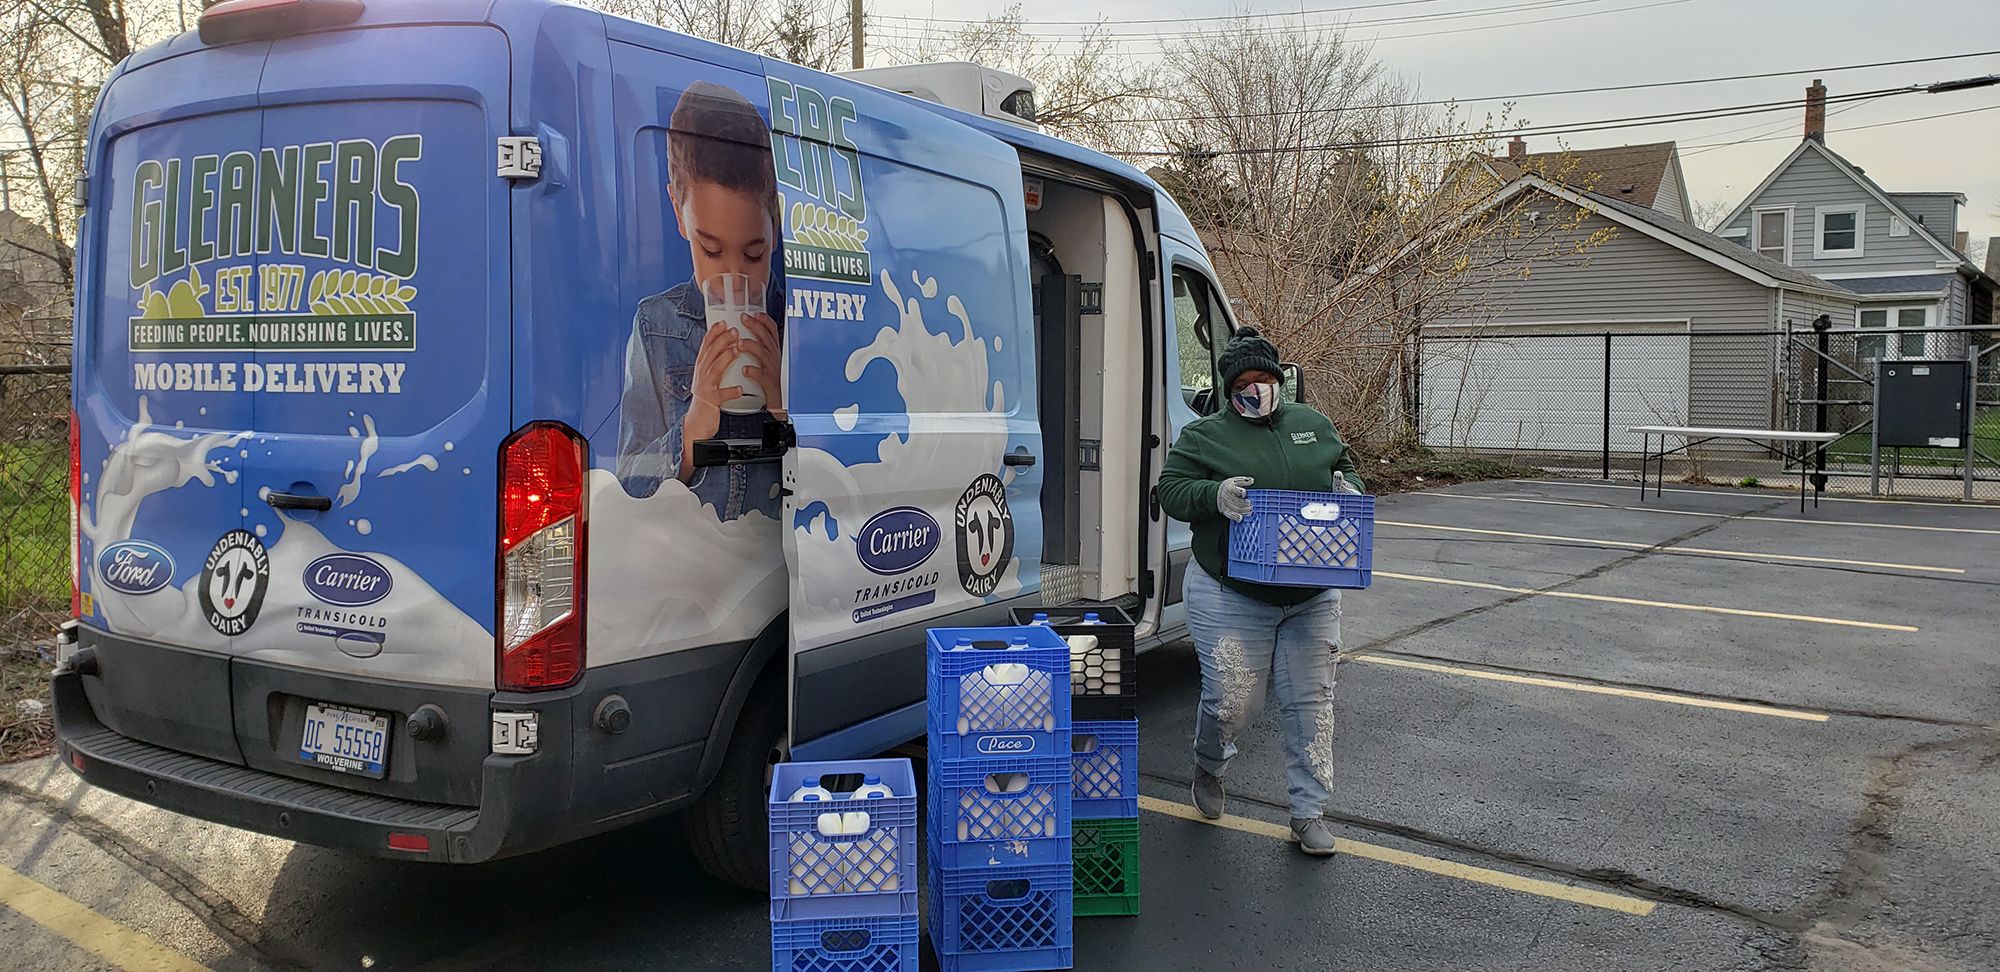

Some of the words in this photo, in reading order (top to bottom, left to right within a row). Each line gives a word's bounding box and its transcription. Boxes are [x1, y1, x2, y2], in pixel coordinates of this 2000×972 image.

[767, 76, 867, 224] ERS
[130, 134, 422, 290] GLEANERS
[831, 255, 868, 277] LIVES.
[215, 265, 253, 312] EST.
[258, 264, 305, 311] 1977
[134, 324, 184, 343] FEEDING
[189, 323, 245, 343] PEOPLE.
[249, 322, 347, 342] NOURISHING
[355, 321, 409, 342] LIVES.
[134, 362, 236, 391] MOBILE
[243, 362, 405, 394] DELIVERY
[956, 477, 1011, 528] UNDENIABLY
[205, 531, 269, 577] UNDENIABLY
[870, 524, 930, 556] Carrier
[107, 547, 160, 587] Ford
[315, 565, 381, 591] Carrier
[966, 568, 998, 594] DAIRY
[854, 571, 939, 603] TRANSICOLD
[210, 612, 247, 634] DAIRY
[297, 607, 387, 628] TRANSICOLD
[304, 719, 325, 750] DC
[333, 723, 382, 762] 55558
[989, 737, 1023, 751] Pace
[317, 753, 363, 771] WOLVERINE
